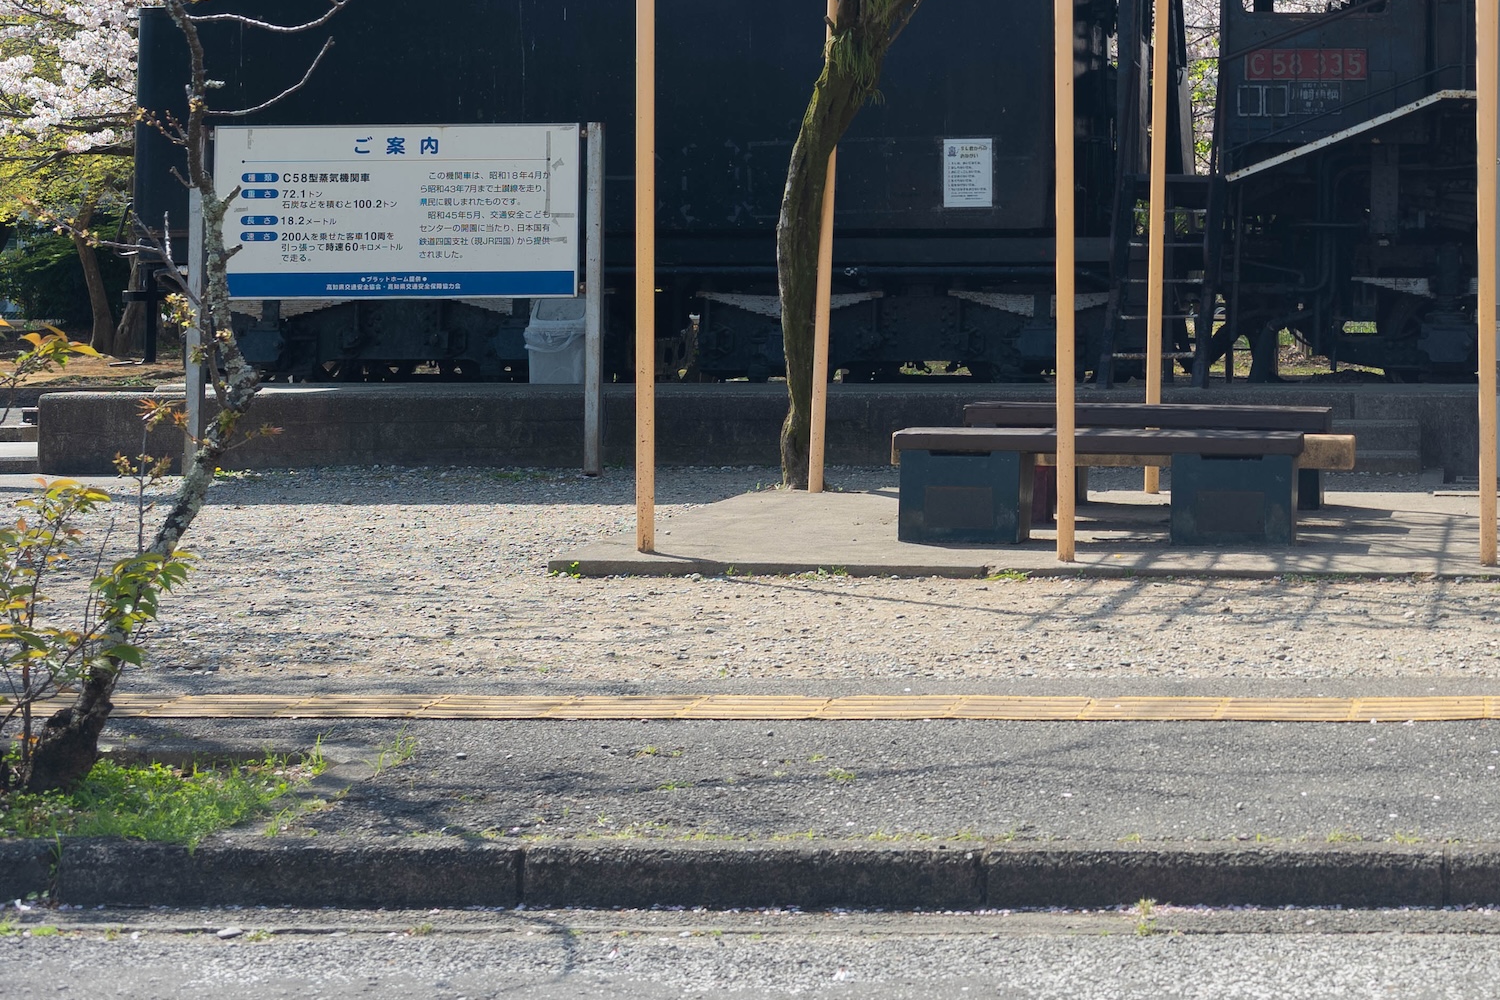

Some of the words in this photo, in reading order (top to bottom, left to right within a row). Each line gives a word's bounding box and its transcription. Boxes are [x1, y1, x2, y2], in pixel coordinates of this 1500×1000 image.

[1312, 53, 1362, 76] 335
[354, 136, 439, 155] ご案内
[282, 172, 371, 183] C58型蒸気機関車
[282, 189, 323, 199] 72.1トン
[281, 199, 398, 209] 石炭などを積むと100.2トン
[419, 197, 522, 207] 県民に親しまれたものです。
[280, 216, 337, 226] 18.2メートル
[281, 232, 394, 242] 200人を乗せた客車10両を
[281, 253, 312, 263] で走る。
[418, 250, 464, 259] されました。
